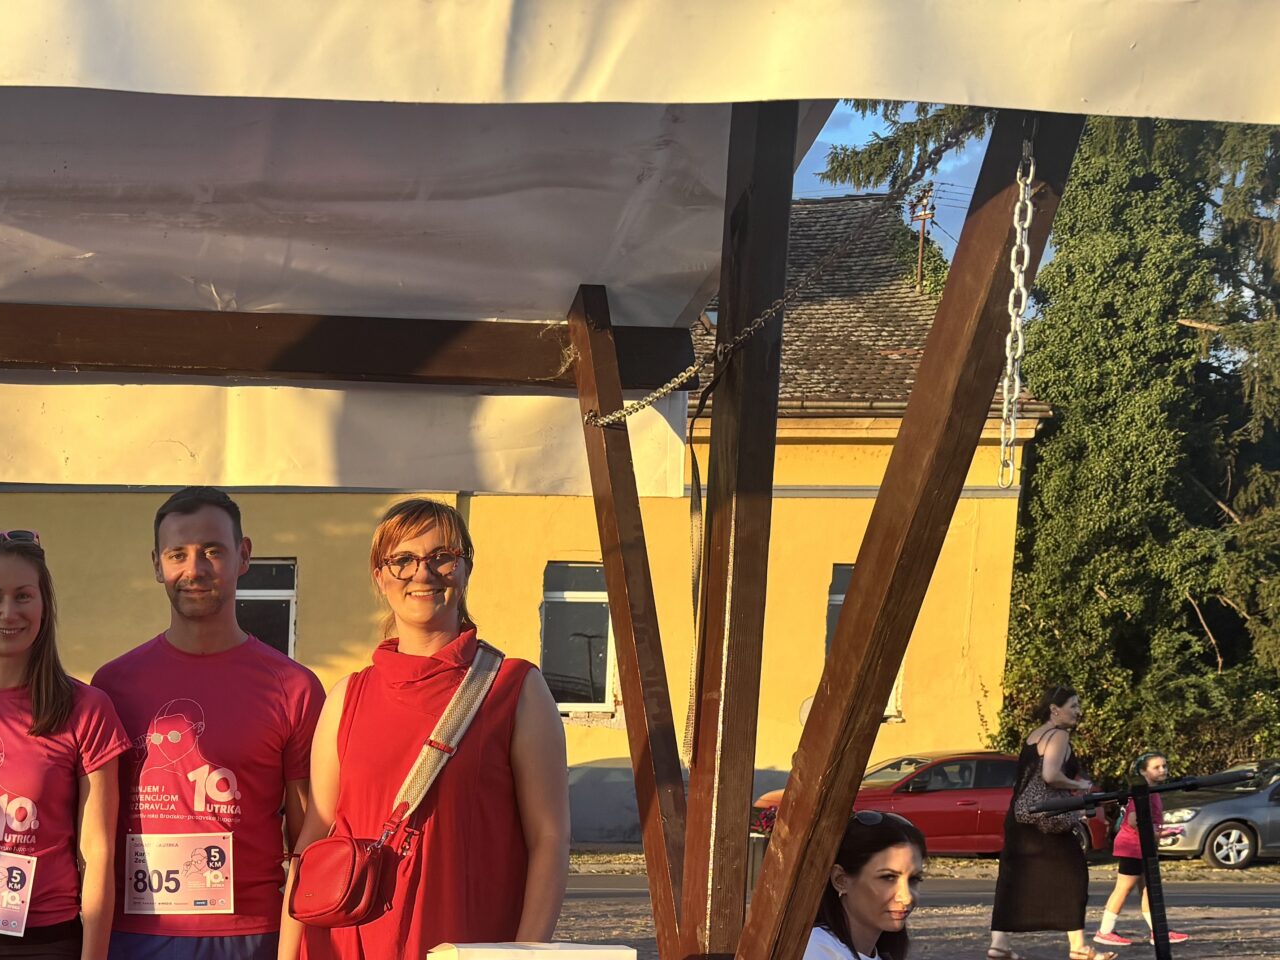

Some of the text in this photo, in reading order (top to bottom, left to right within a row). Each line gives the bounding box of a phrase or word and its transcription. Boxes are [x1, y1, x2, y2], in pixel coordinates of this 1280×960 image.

[187, 764, 241, 812] 10.
[206, 803, 242, 814] UTRKA
[4, 833, 36, 844] UTRKA
[210, 848, 220, 861] 5
[10, 869, 21, 882] 5
[133, 869, 180, 893] 805
[8, 882, 21, 890] KM
